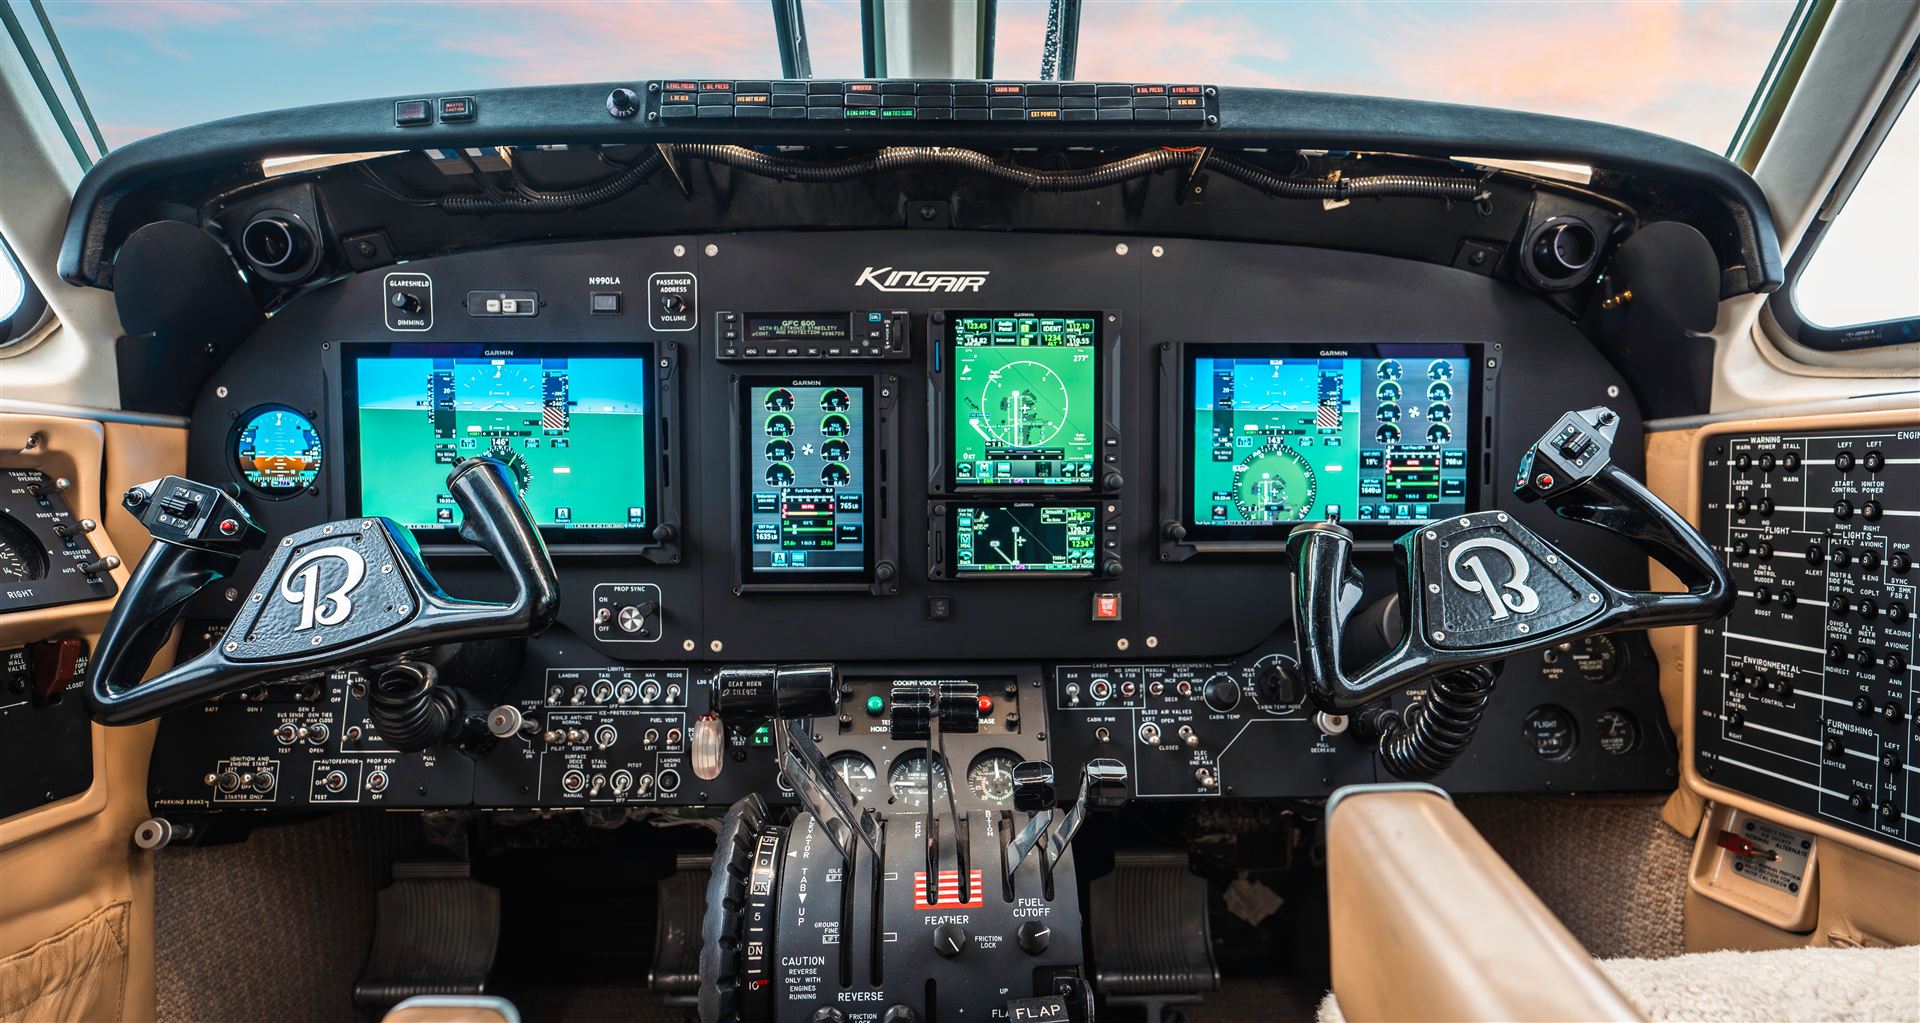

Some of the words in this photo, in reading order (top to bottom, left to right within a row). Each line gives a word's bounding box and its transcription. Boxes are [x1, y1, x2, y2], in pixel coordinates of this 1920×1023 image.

[618, 106, 634, 116] TEST
[589, 277, 620, 285] N990LA
[7, 589, 34, 599] RIGHT
[1885, 628, 1911, 637] READING
[1744, 656, 1800, 673] ENVIRONMENTAL
[1856, 672, 1876, 680] FLUOR
[1888, 690, 1902, 698] TAXI
[1827, 718, 1873, 736] FURNISHING
[1828, 727, 1844, 736] CIGAR
[1884, 742, 1900, 750] LEFT
[1823, 759, 1846, 770] LIGHTER
[1852, 780, 1872, 790] TOILET
[1885, 783, 1896, 791] LDG
[1882, 825, 1898, 835] RIGHT
[1018, 898, 1044, 907] FUEL
[798, 908, 804, 926] UP
[1013, 908, 1050, 917] CUTOFF
[925, 915, 969, 925] FEATHER
[748, 946, 763, 956] DN
[782, 957, 825, 966] CAUTION
[838, 992, 883, 1001] REVERSE
[1016, 1004, 1061, 1020] FLAP
